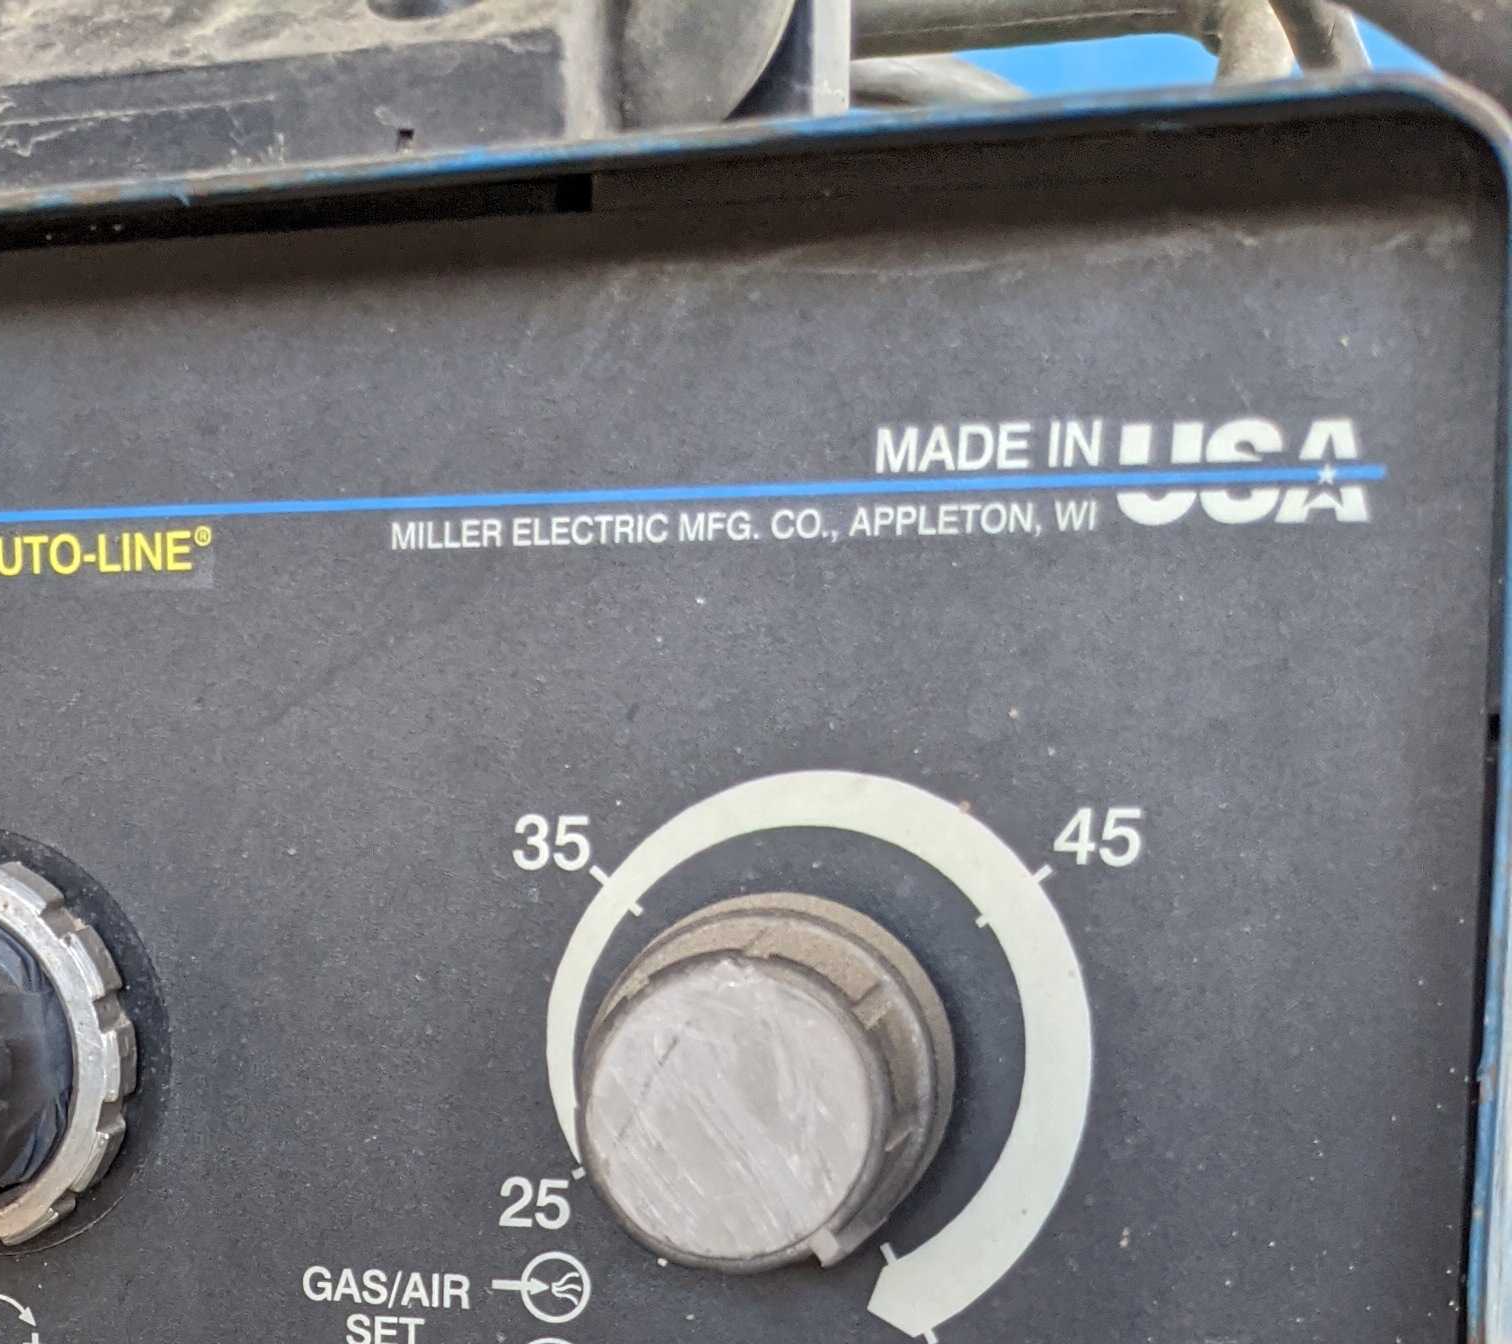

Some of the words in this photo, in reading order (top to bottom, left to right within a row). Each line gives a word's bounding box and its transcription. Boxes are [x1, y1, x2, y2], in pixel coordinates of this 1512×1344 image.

[875, 422, 1033, 473] MADE
[1048, 419, 1102, 468] IN
[1116, 417, 1370, 526] USA
[390, 517, 502, 550] MILLER
[512, 512, 669, 547] ELECTRIC
[679, 510, 760, 543] MFG.
[770, 508, 839, 543] CO.,
[849, 500, 1042, 538] APPLETON,
[1054, 500, 1097, 532] WI
[512, 813, 591, 872] 35
[1052, 806, 1144, 869] 45
[498, 1176, 571, 1230] 25
[302, 1265, 470, 1310] GAS/AIR
